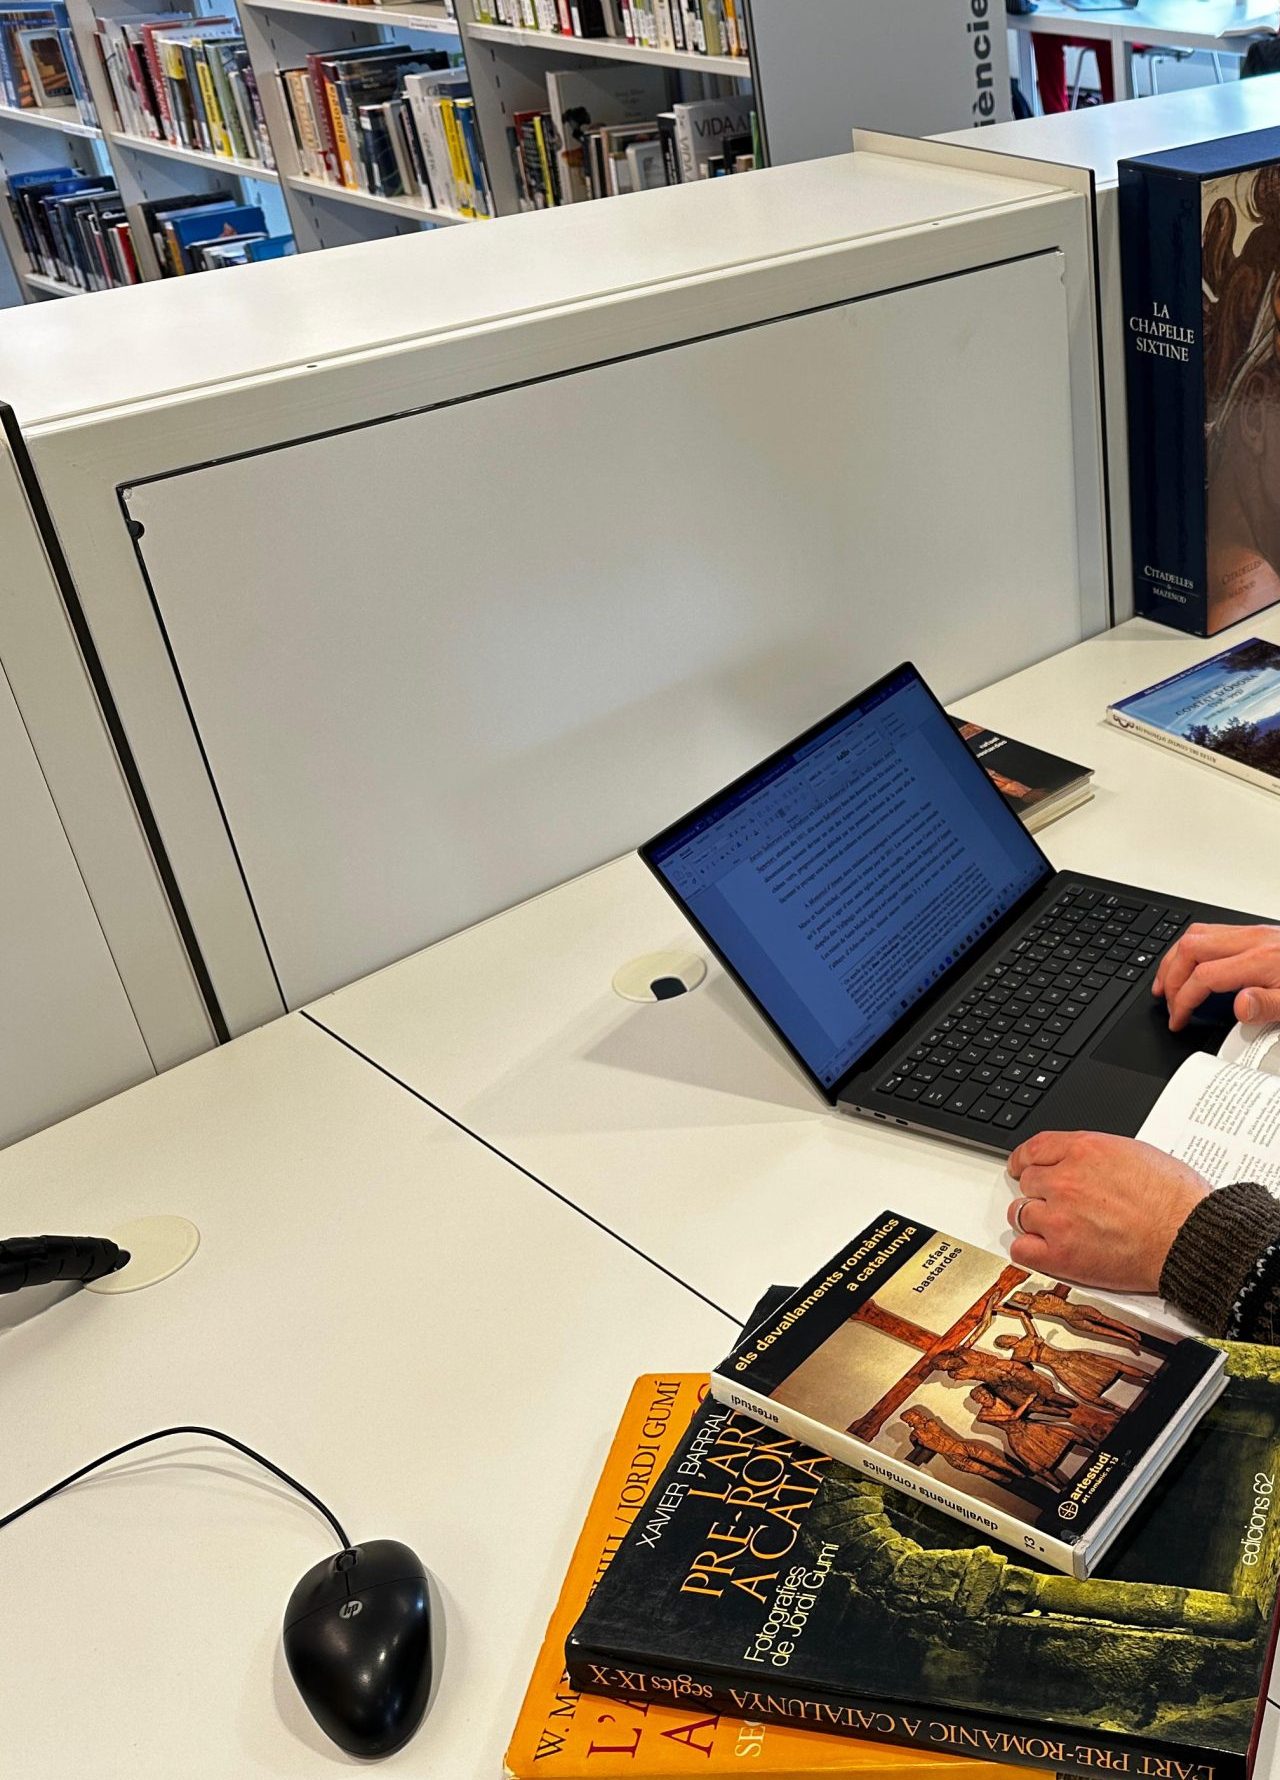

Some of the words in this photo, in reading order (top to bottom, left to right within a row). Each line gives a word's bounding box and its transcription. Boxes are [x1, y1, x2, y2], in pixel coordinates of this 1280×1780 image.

[1152, 301, 1170, 319] LA
[1129, 316, 1195, 344] CHAPELLE
[1136, 336, 1190, 362] SIXTINE
[1143, 564, 1195, 590] CITADELLES
[846, 1281, 860, 1293] a
[857, 1225, 918, 1282] catalunya
[912, 1246, 963, 1294] bastardes
[921, 1241, 952, 1269] rafael
[734, 1352, 758, 1372] els
[756, 1269, 844, 1352] davallaments
[841, 1217, 900, 1272] romànics
[731, 1394, 779, 1423] artestudi
[618, 1443, 660, 1512] JORDI
[642, 1380, 682, 1440] GUMÍ
[1109, 1456, 1119, 1465] 13
[636, 1481, 690, 1549] XAVIER
[678, 1409, 732, 1476] BARRAL
[1071, 1452, 1112, 1501] artestudi
[1252, 1472, 1276, 1493] 62
[921, 1486, 999, 1530] davallaments
[1024, 1535, 1036, 1550] 13
[1241, 1494, 1271, 1567] edicions
[802, 1540, 840, 1589] Gumí
[730, 1571, 781, 1605] A
[744, 1566, 806, 1663] Fotografies
[789, 1591, 818, 1638] Jordi
[771, 1640, 796, 1667] de
[588, 1664, 648, 1692] IX-X
[652, 1675, 713, 1699] segles
[729, 1688, 896, 1733] CATALUNYA
[902, 1716, 921, 1735] A
[533, 1728, 570, 1762] W.
[929, 1717, 1131, 1772] PRE-ROMÀNIC
[1137, 1756, 1216, 1780] L'ART
